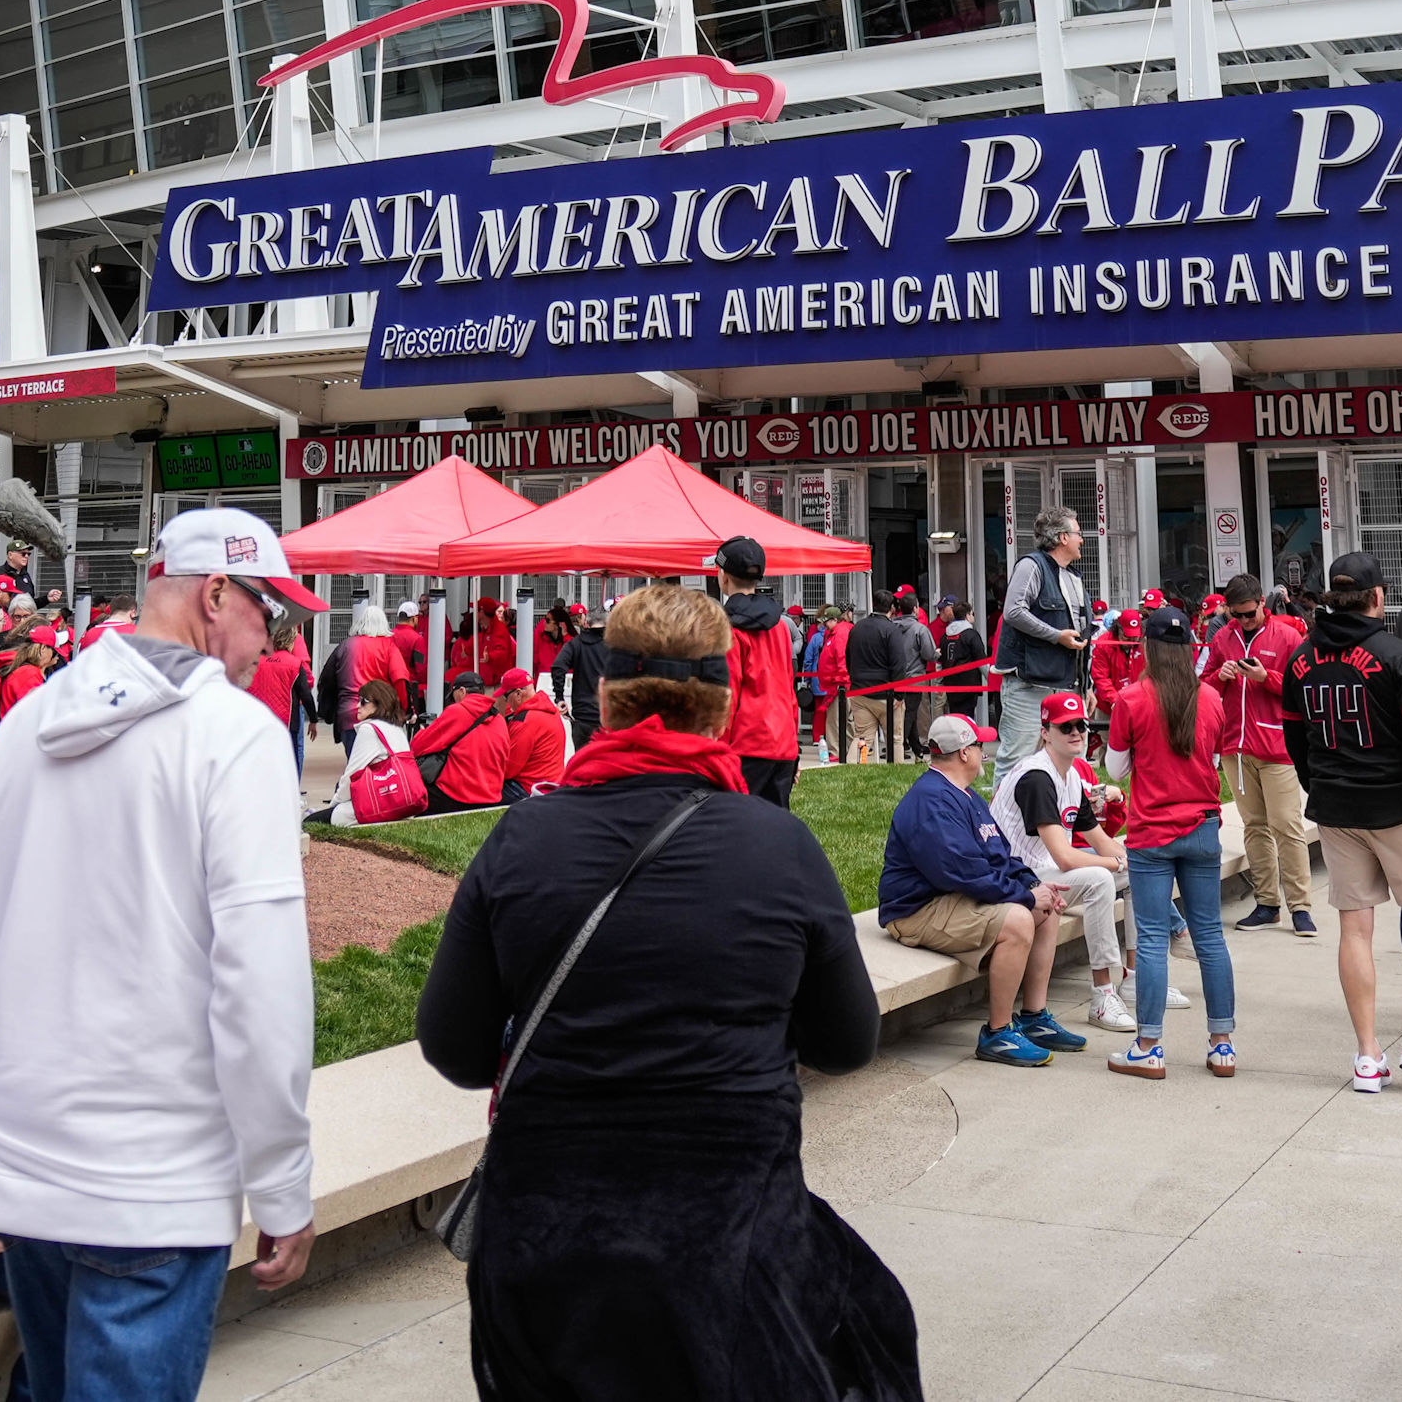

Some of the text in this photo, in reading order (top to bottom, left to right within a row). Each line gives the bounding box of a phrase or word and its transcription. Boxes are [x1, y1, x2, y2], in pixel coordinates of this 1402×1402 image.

[168, 189, 432, 284] GREAT
[396, 168, 913, 288] AMERICAN
[946, 133, 1261, 245] BALL
[380, 315, 493, 361] Presented
[495, 313, 535, 358] by
[545, 291, 702, 348] GREAT
[720, 268, 1000, 336] AMERICAN
[1030, 243, 1392, 316] INSURANCE
[21, 379, 65, 396] TERRACE
[334, 436, 442, 474] HAMILTON
[548, 422, 681, 466] WELCOMES
[694, 418, 749, 459] YOU
[807, 414, 859, 456] 100
[869, 411, 918, 454] JOE
[929, 404, 1068, 451] NUXHALL
[1077, 400, 1148, 444] WAY
[1254, 393, 1356, 437] HOME
[166, 457, 213, 475] GO-AHEAD
[225, 452, 272, 471] GO-AHEAD
[824, 492, 832, 530] OPEN
[1005, 485, 1013, 545] OPEN 10
[1097, 483, 1105, 536] OPEN 9
[1320, 476, 1330, 530] OPEN 8
[1292, 654, 1311, 680] DE
[1303, 684, 1374, 750] 44
